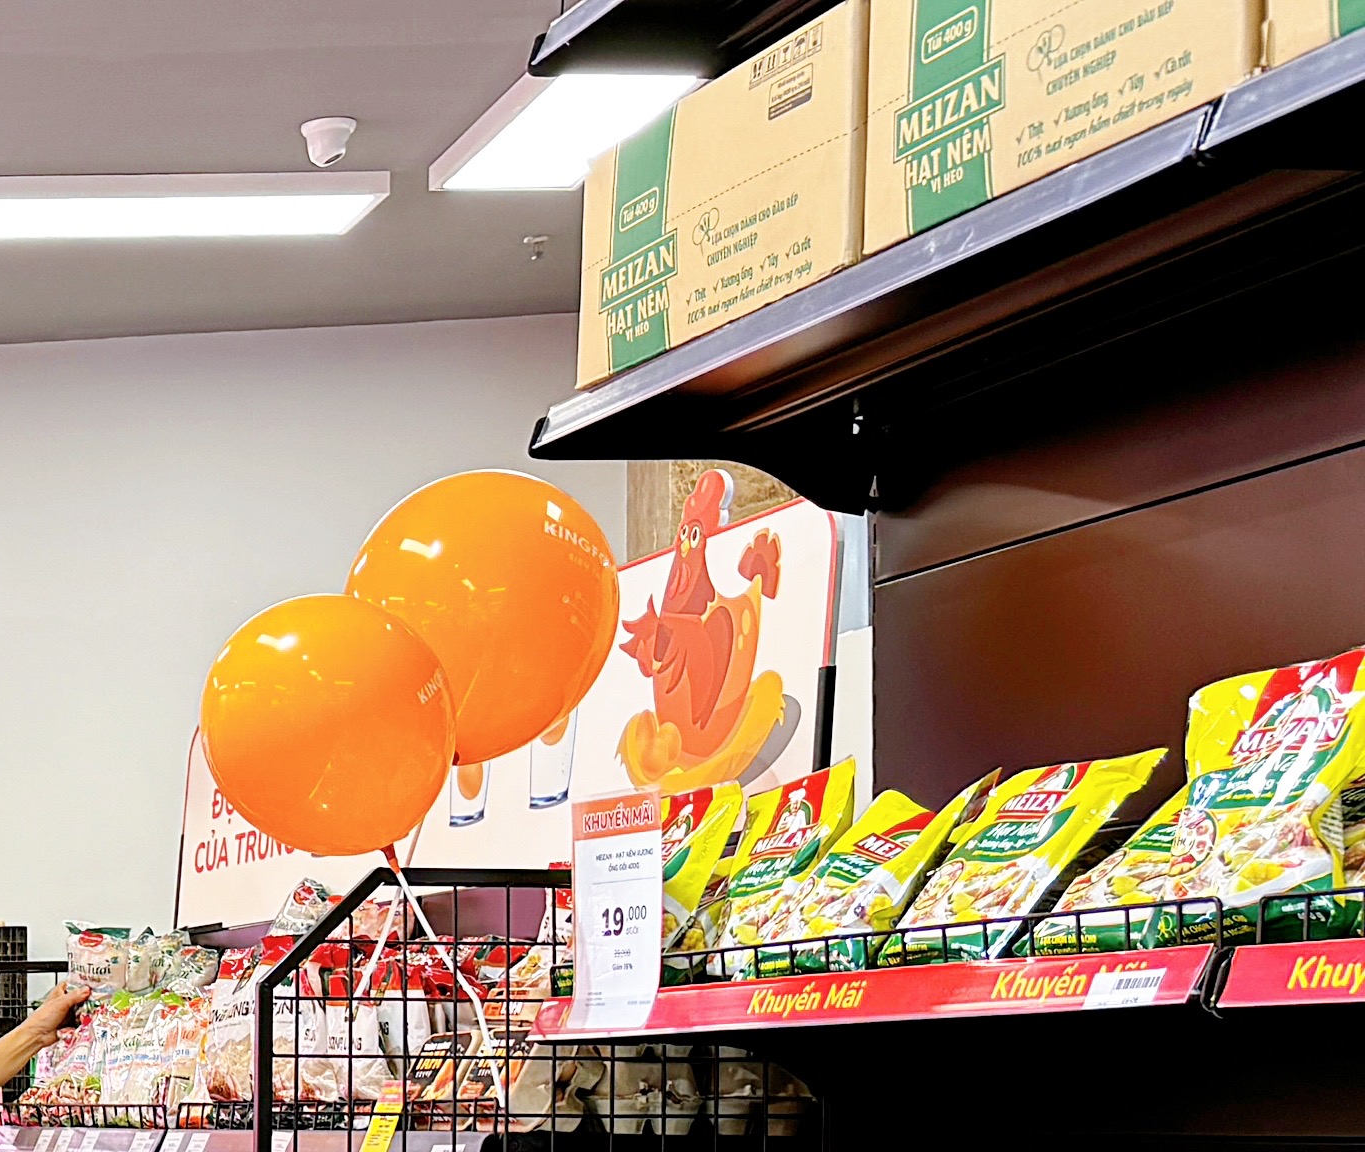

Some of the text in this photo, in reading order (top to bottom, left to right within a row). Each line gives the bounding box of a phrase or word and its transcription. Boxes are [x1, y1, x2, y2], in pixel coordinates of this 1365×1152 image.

[898, 67, 1002, 150] MEIZAN
[905, 124, 992, 189] HẠT NÊM
[931, 167, 963, 194] VỊ HEO
[602, 241, 674, 302] MEIZAN
[607, 284, 668, 338] HẠT NÊM
[635, 321, 649, 338] HEO
[632, 801, 654, 824] MÃI
[195, 829, 228, 873] CỦA
[747, 980, 821, 1016] Khuyến
[824, 978, 866, 1009] Mãi
[991, 961, 1087, 999] Khuyến
[1287, 955, 1365, 995] Khuy
